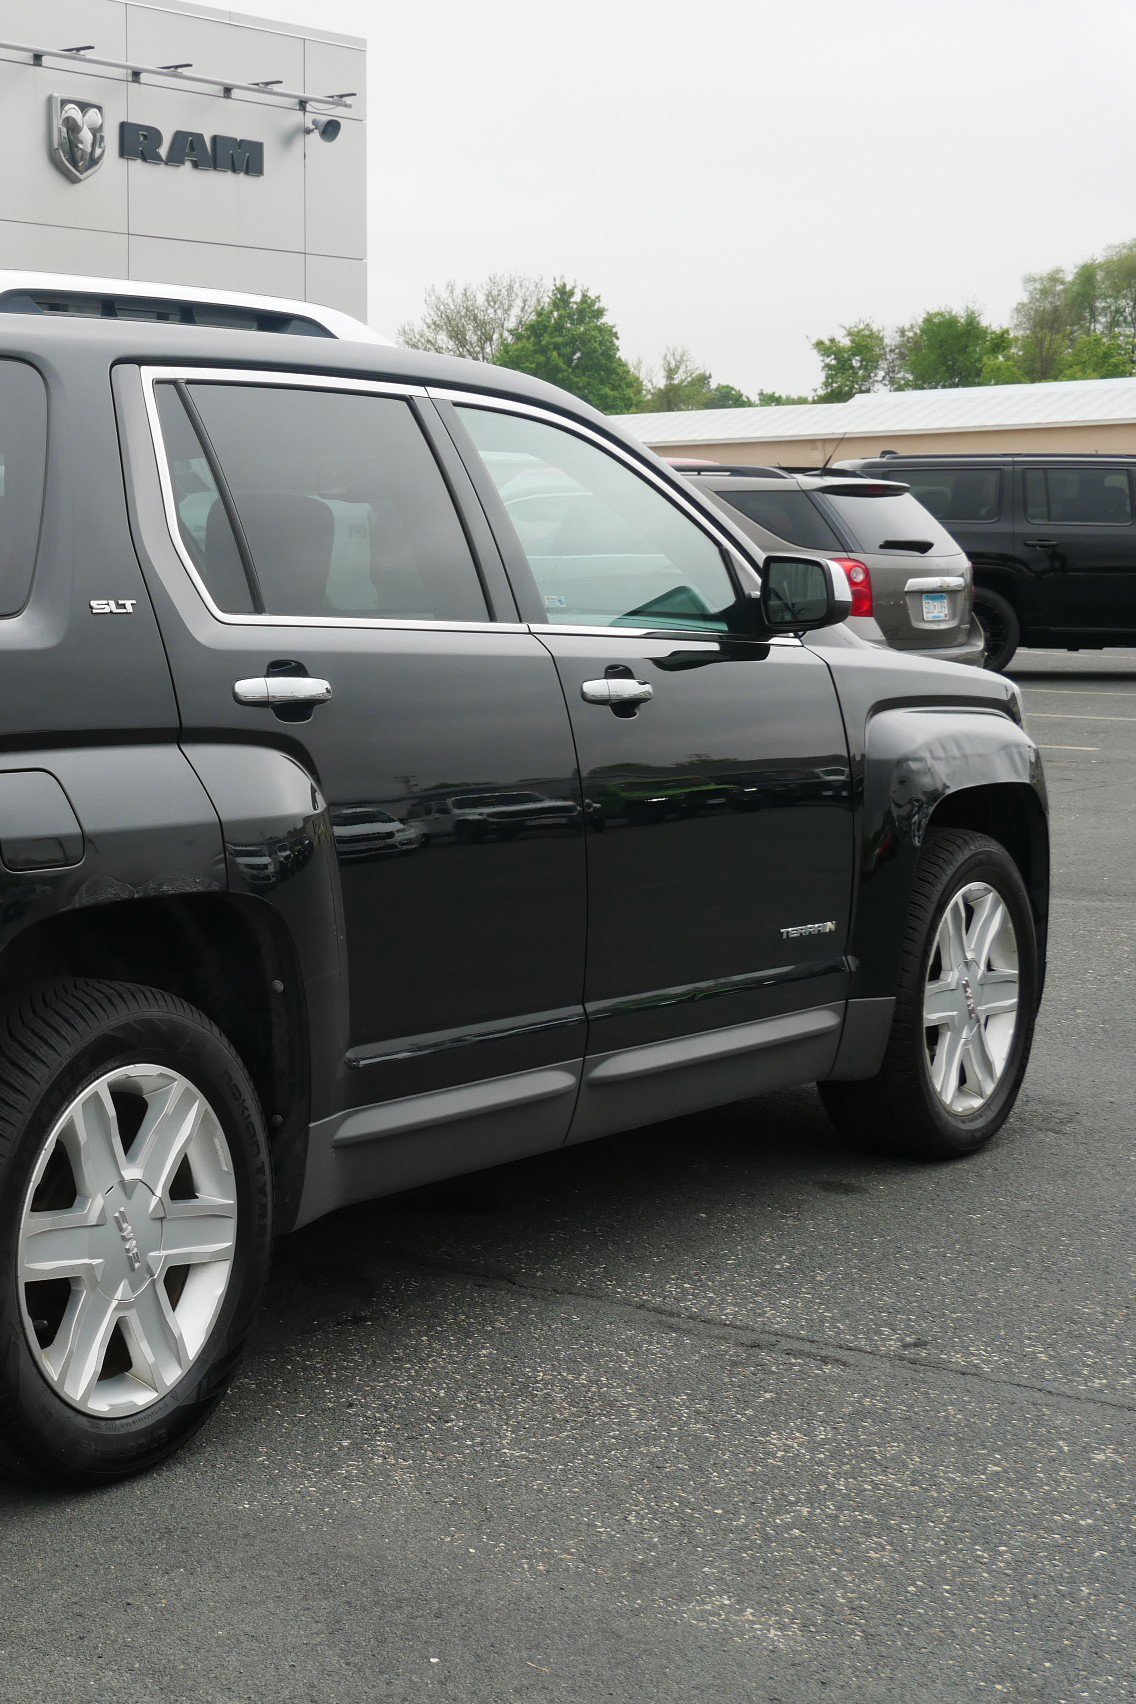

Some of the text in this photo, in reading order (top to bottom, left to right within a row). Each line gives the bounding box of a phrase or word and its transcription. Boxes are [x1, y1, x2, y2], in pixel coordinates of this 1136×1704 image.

[119, 120, 264, 177] RAM
[90, 599, 136, 614] SLT
[780, 920, 836, 940] TERRAIN
